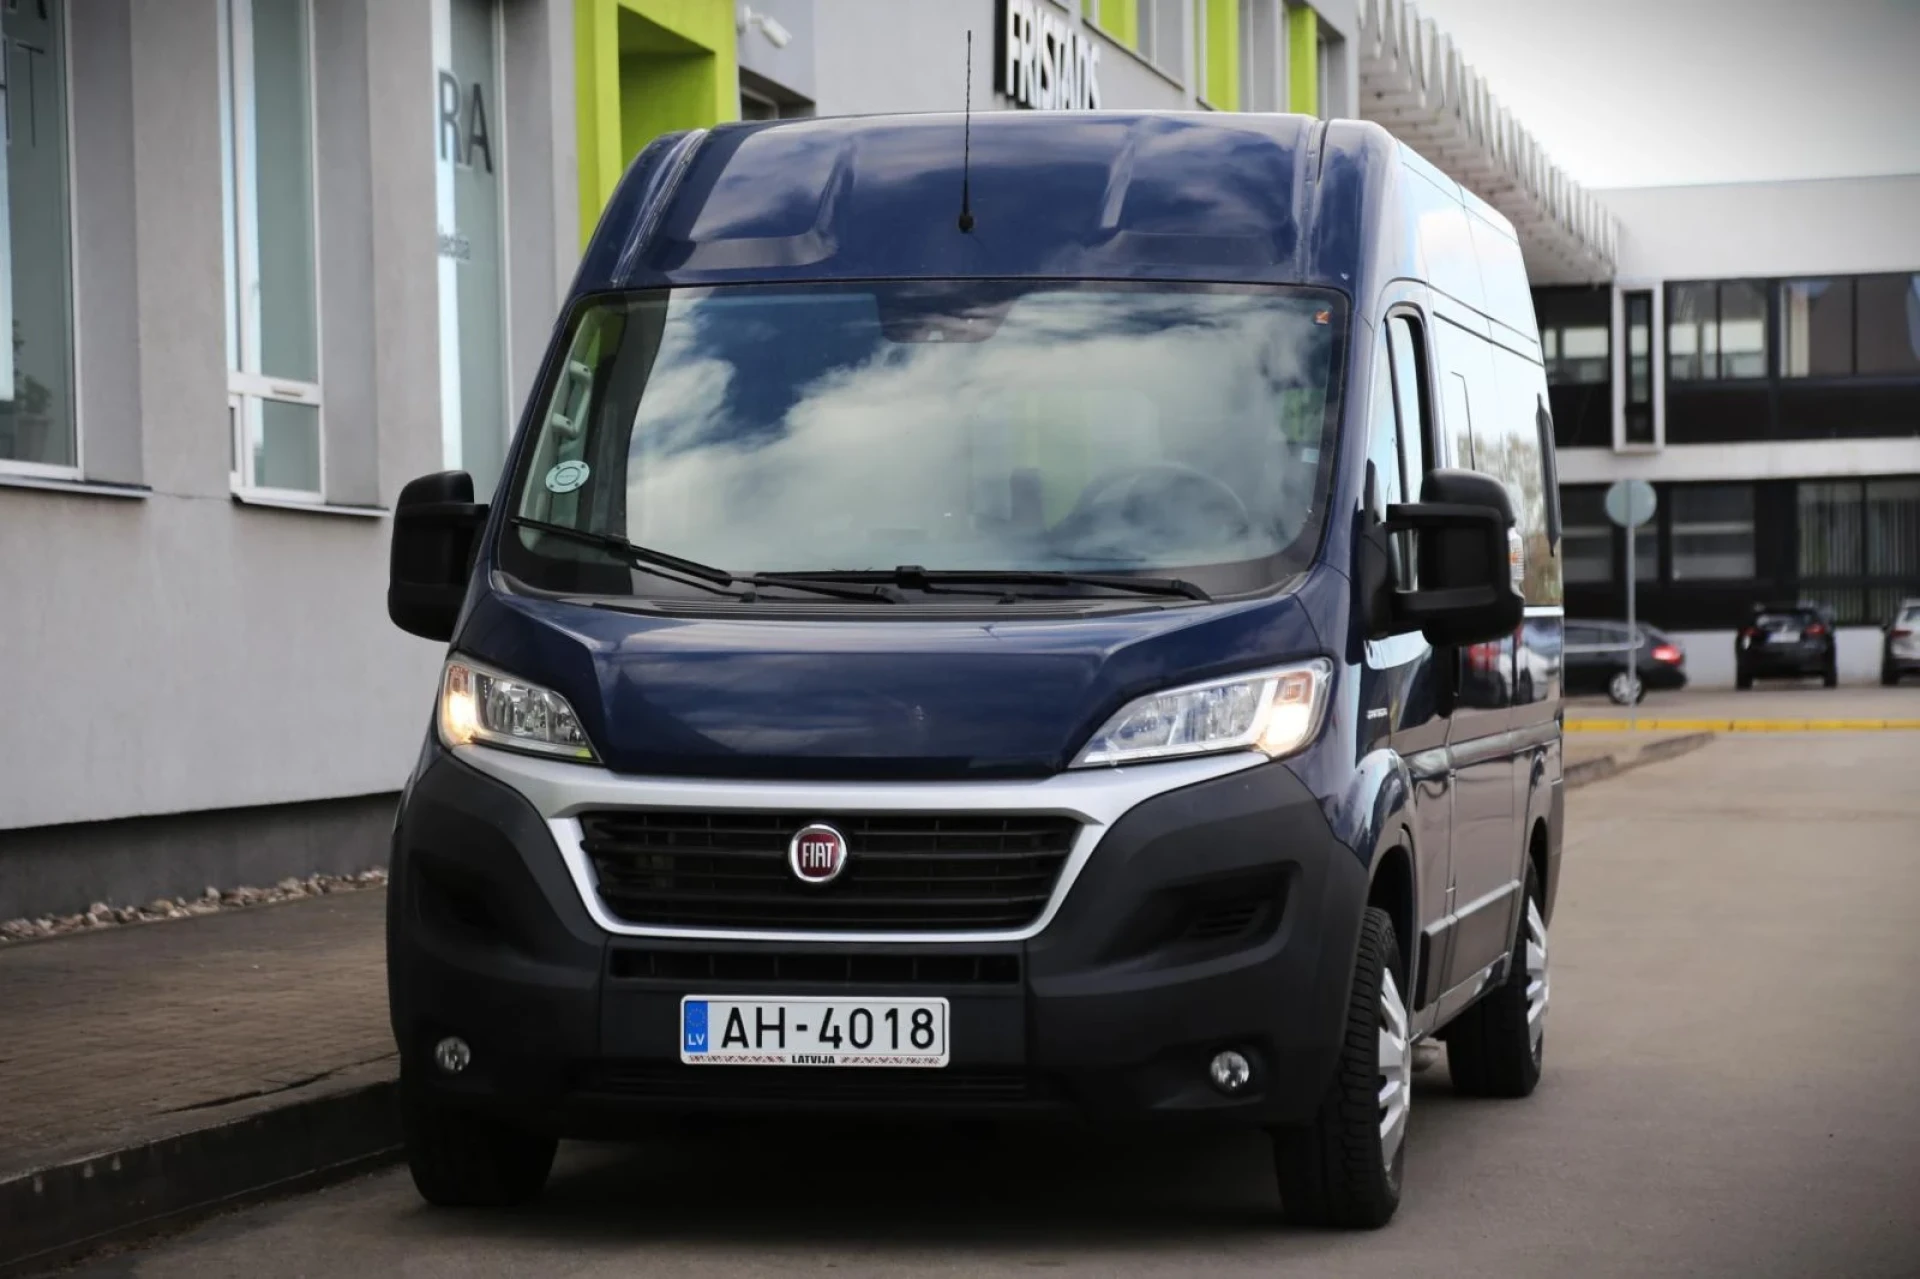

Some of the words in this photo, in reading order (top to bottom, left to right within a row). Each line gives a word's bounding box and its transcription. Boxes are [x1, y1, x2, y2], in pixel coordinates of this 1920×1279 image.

[802, 842, 834, 868] FIAT
[688, 1034, 705, 1046] LV
[721, 1006, 935, 1050] AH-4018
[791, 1055, 836, 1065] LATVIJA
